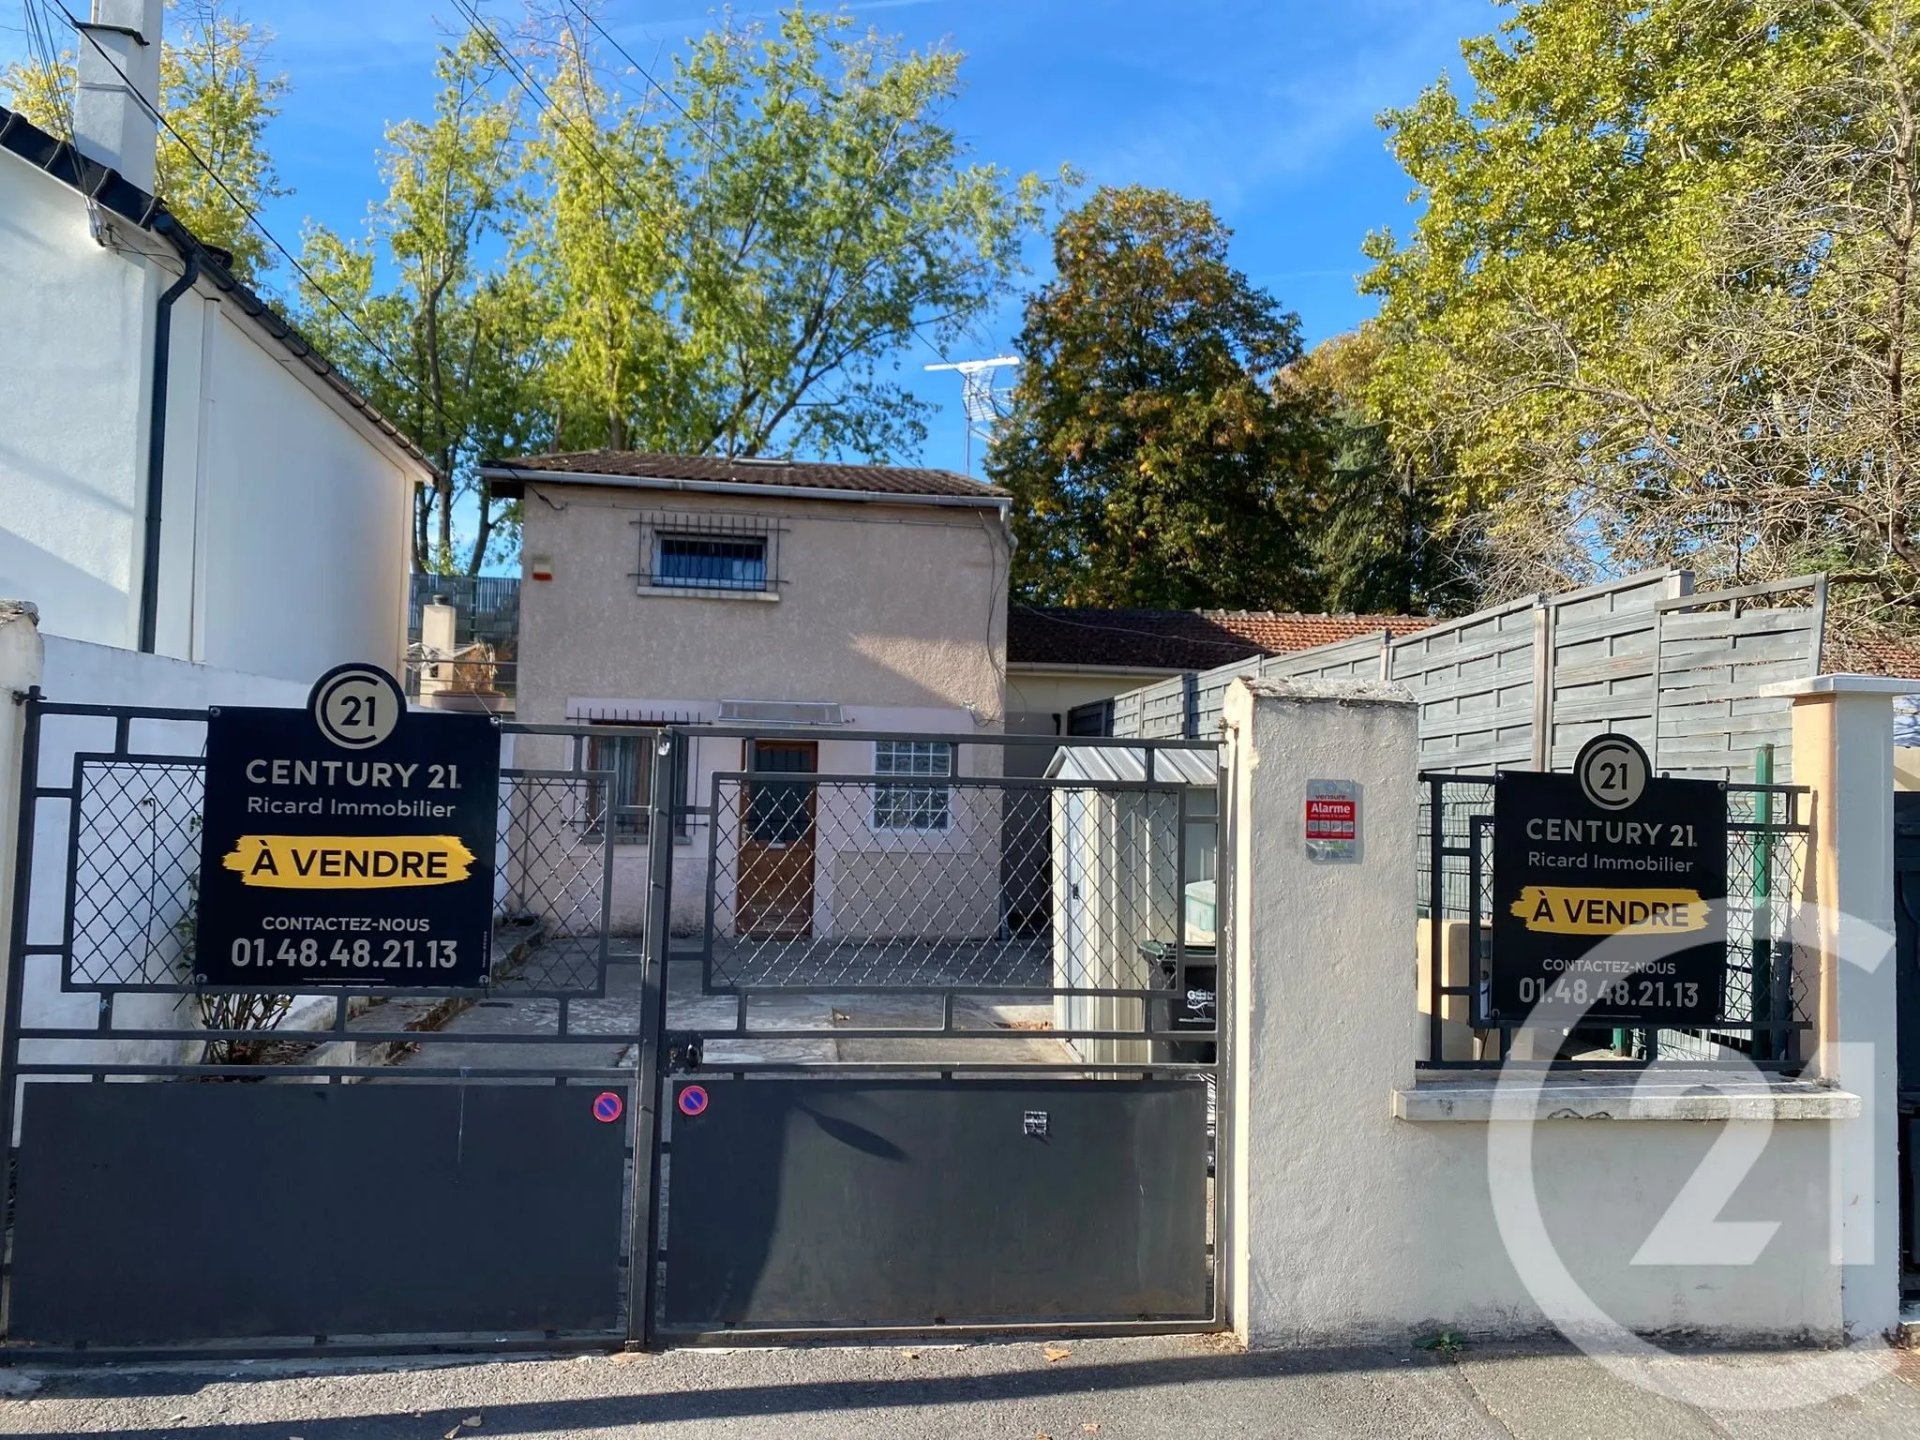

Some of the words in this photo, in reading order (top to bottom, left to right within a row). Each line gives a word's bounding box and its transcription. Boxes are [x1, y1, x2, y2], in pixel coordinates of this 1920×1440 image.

[245, 759, 419, 789] CENTURY
[247, 796, 323, 815] Ricard
[330, 798, 456, 818] Immobilier
[1311, 802, 1351, 813] Alarme
[1526, 818, 1663, 846] CENTURY
[250, 839, 279, 876] À
[291, 848, 448, 879] VENDRE
[1528, 851, 1588, 869] Ricard
[1594, 854, 1693, 873] Immobilier
[1532, 890, 1555, 923] À
[1563, 898, 1689, 927] VENDRE
[262, 916, 430, 932] CONTACTEZ-NOUS
[231, 937, 458, 968] 01.48.48.21.13
[1542, 958, 1676, 975] CONTACTEZ-NOUS
[1519, 977, 1699, 1008] 01.48.48.21.13
